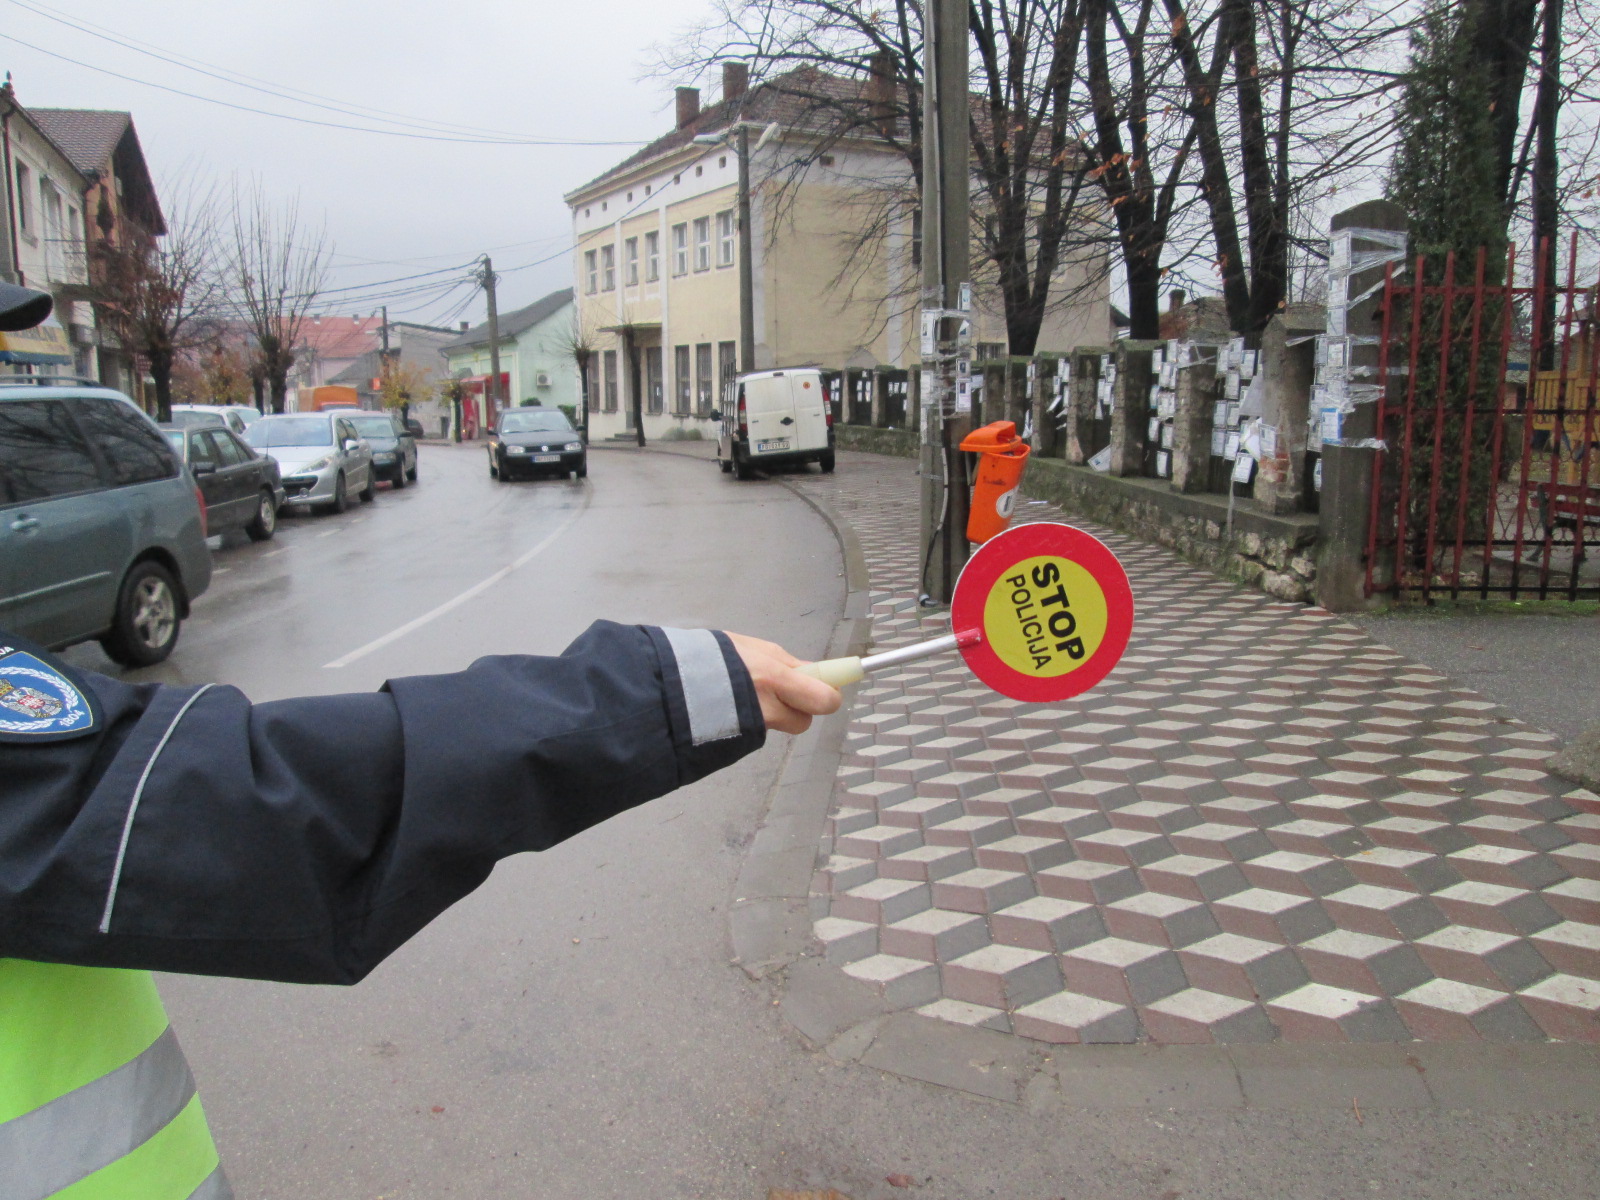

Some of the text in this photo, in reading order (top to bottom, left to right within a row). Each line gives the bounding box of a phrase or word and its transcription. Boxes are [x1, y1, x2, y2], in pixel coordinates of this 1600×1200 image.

[1005, 574, 1052, 670] POLICIJA
[1031, 562, 1085, 660] STOP
[59, 709, 85, 727] 1804
